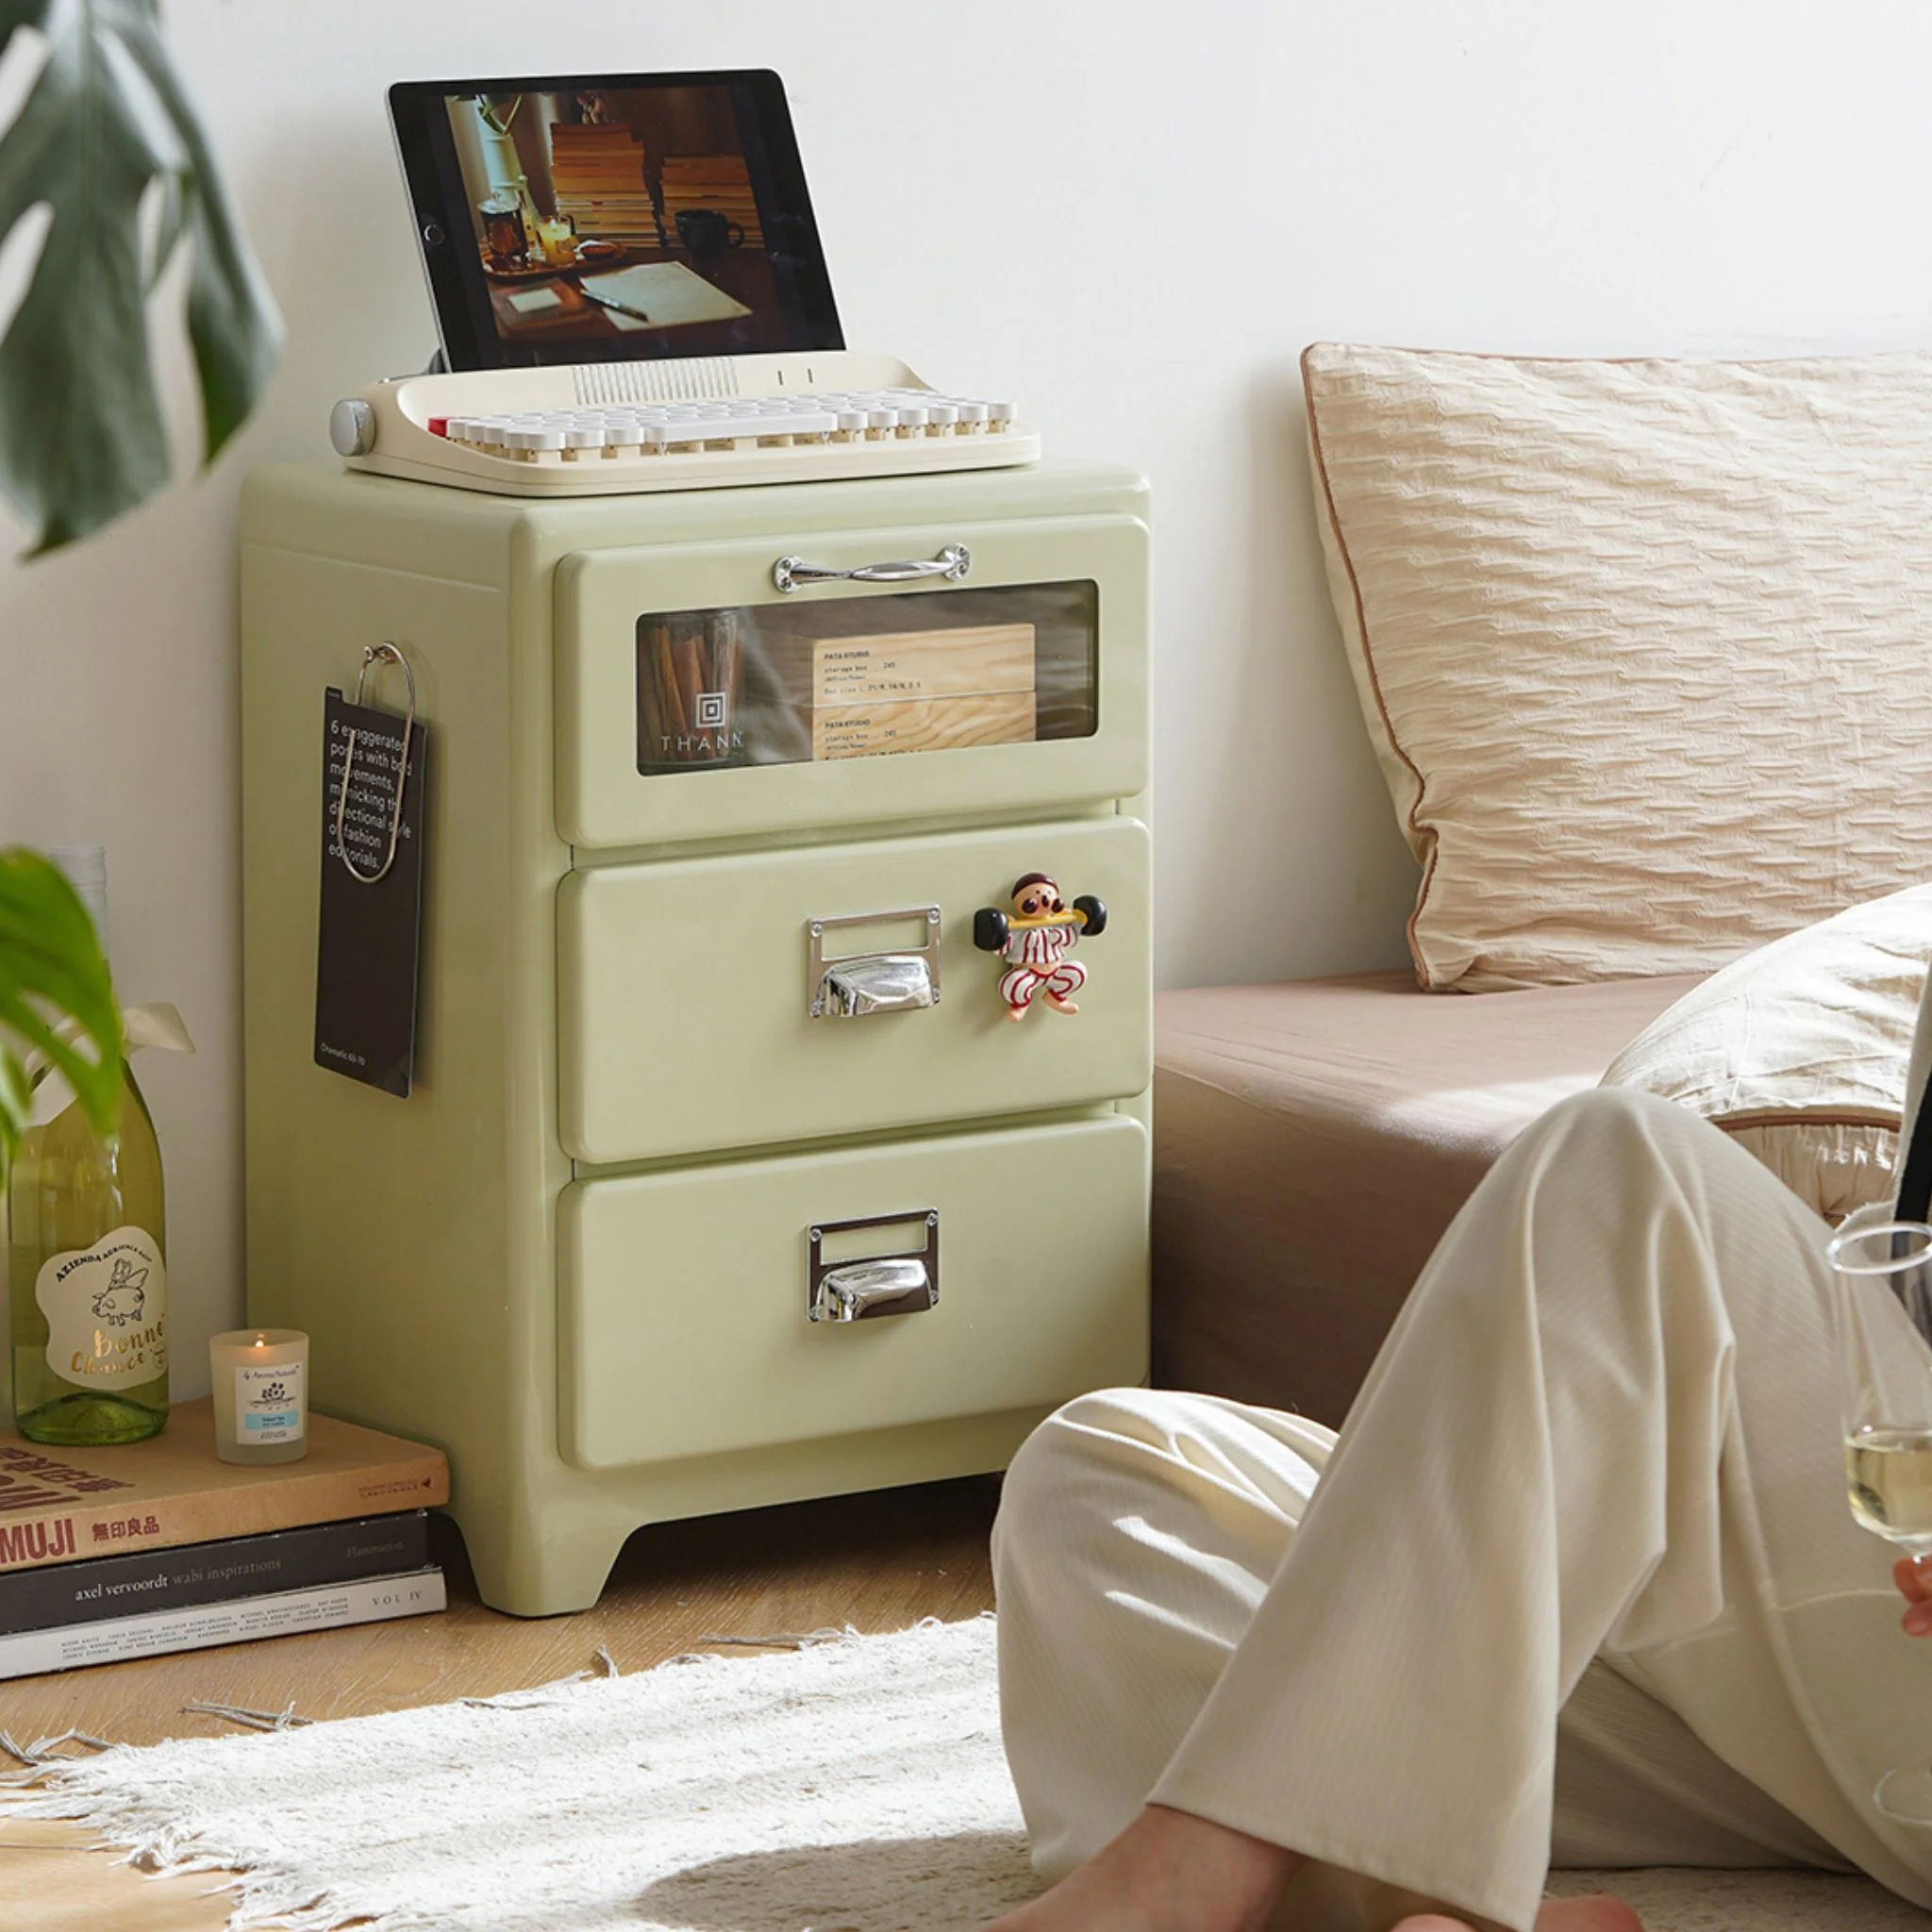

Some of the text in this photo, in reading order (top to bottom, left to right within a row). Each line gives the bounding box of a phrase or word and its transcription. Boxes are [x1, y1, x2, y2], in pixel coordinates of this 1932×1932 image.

[330, 719, 408, 752] 6 eaggerate
[330, 741, 413, 777] poes with bod
[330, 782, 403, 814] mmicking th
[329, 800, 412, 840] dectional syle
[343, 825, 382, 849] fashion
[328, 841, 381, 870] edorials.
[56, 1254, 103, 1283] AZIENDA
[92, 1320, 164, 1359] Bonne
[71, 1350, 145, 1376] Chance
[0, 1517, 76, 1564] MUJI
[92, 1515, 160, 1542] 無印良品
[75, 1582, 103, 1602] axel
[106, 1573, 169, 1596] vervoordt
[172, 1568, 205, 1586] wabi
[206, 1557, 282, 1582] inspirations
[372, 1590, 424, 1607] VOL IV
